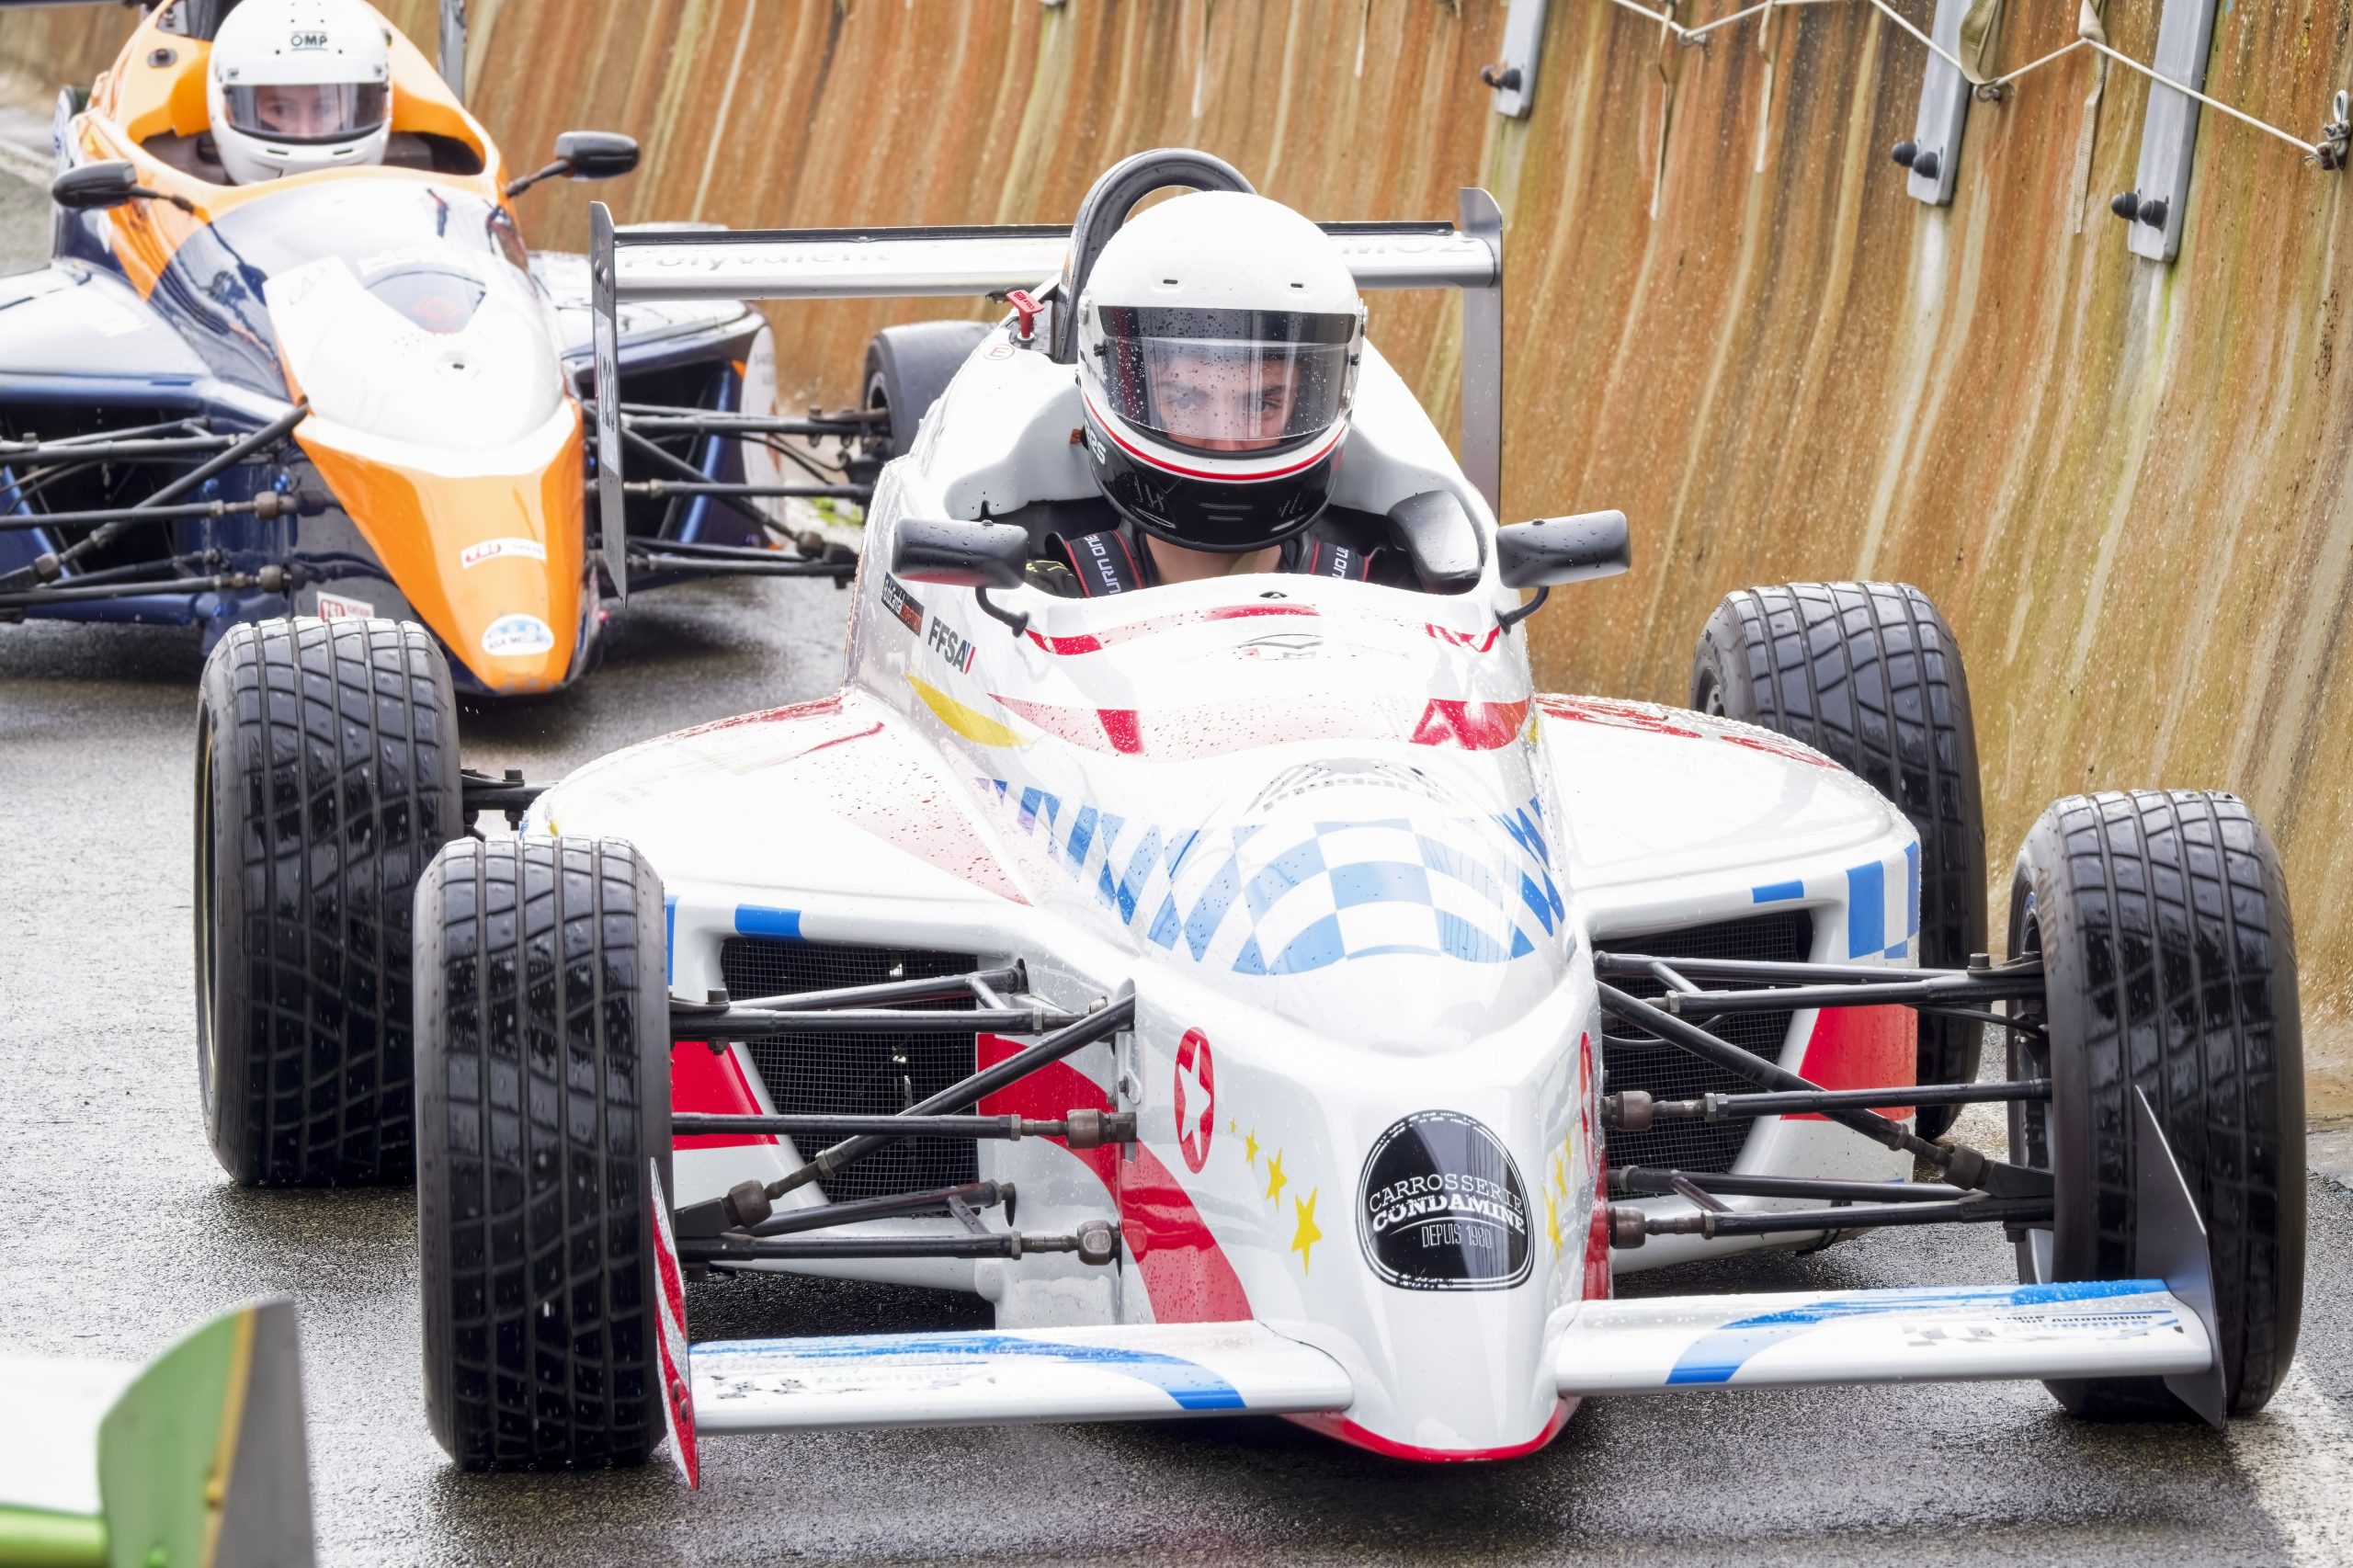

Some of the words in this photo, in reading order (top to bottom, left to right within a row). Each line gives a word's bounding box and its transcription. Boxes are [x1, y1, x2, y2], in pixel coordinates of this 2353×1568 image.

[290, 34, 328, 48] OMP
[1084, 534, 1108, 557] ONE
[1097, 559, 1122, 596] URN
[927, 615, 967, 674] FFSA
[1369, 1173, 1524, 1216] CARROSSERIE
[1372, 1193, 1526, 1235] CONDAMINE
[1421, 1222, 1461, 1248] DEPUIS
[1465, 1223, 1493, 1249] 1980
